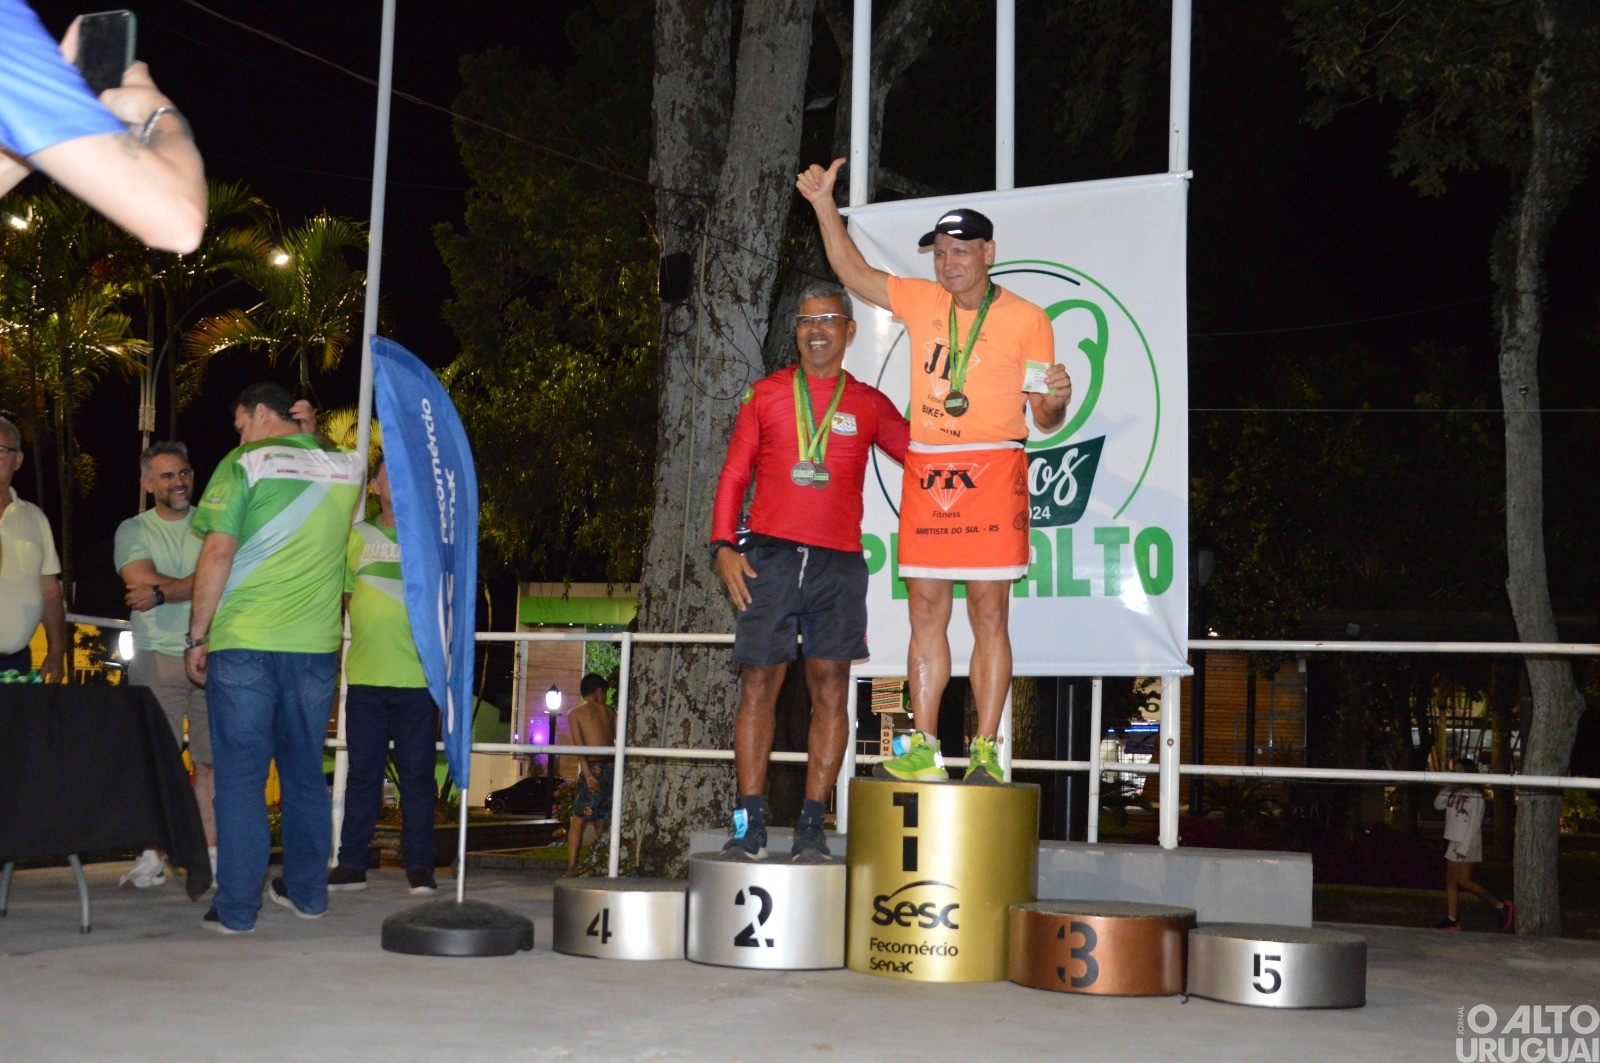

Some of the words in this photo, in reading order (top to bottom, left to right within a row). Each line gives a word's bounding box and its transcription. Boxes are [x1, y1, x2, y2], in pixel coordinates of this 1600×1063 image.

[922, 405, 945, 418] BIKE+
[920, 469, 978, 490] JK
[932, 510, 961, 518] Fitness
[1029, 506, 1051, 519] 24
[916, 526, 949, 535] AMETISTA
[965, 525, 979, 533] SUL
[988, 524, 999, 532] RS
[893, 792, 919, 872] 1
[586, 908, 613, 944] 4
[734, 885, 775, 948] 2
[869, 937, 959, 957] Fecomércio
[1056, 921, 1099, 988] 3
[869, 956, 914, 974] Senac
[1252, 953, 1282, 995] 5
